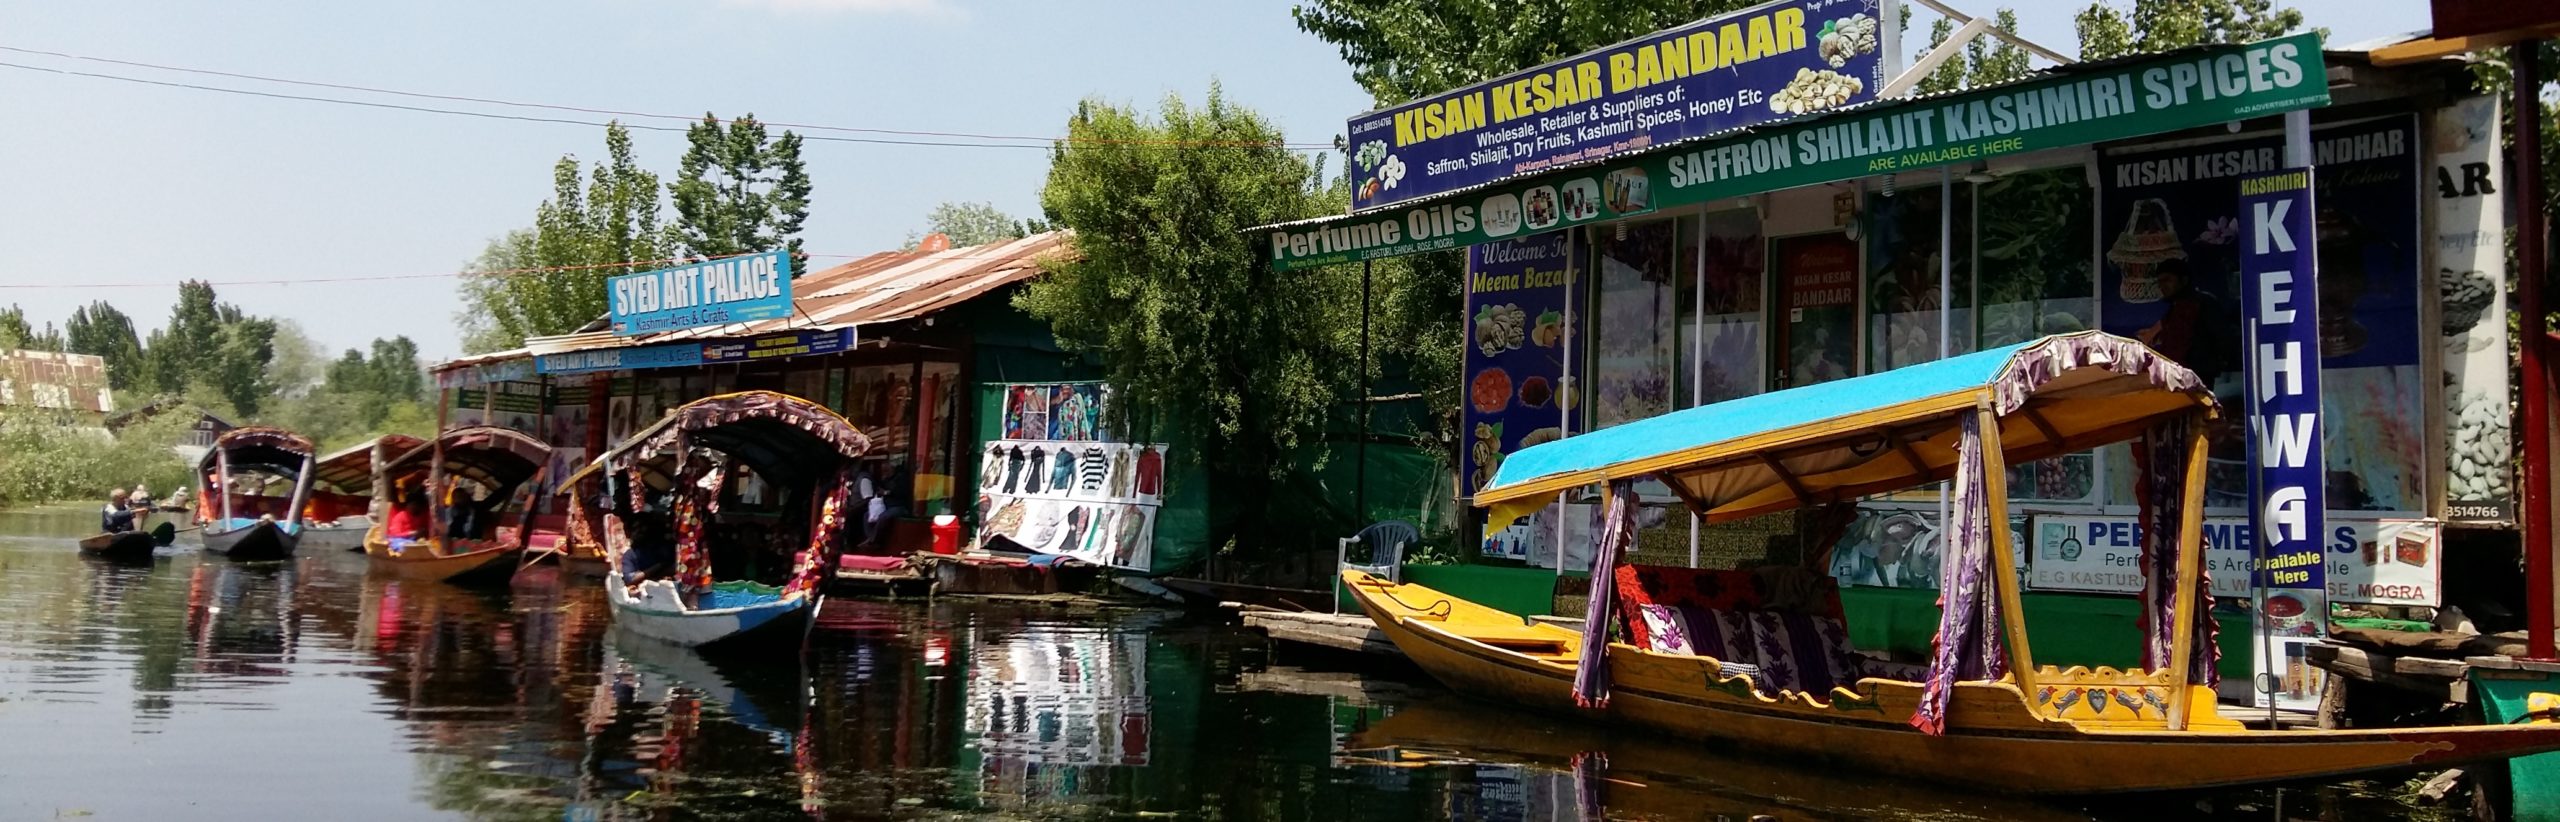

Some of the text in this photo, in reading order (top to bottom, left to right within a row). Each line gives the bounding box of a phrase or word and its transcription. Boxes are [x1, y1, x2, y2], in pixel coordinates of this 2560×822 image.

[1394, 7, 1807, 148] KISAN KESAR BANDAAR
[1476, 85, 1686, 148] Wholesale, Retailer & Suppliers of:
[1668, 43, 2303, 189] SAFFRON SHILAJIT KASHMIRI SPICES
[1352, 124, 1364, 135] Cell:
[1427, 89, 1763, 176] Saffron, Shilajit, Dry Fruits, Kashmiri Spices, Honey Etc
[1868, 137, 2023, 172] ARE AVAILABLE HERE
[2116, 156, 2188, 188] KISAN
[2195, 147, 2275, 180] KESAR
[2241, 172, 2307, 197] KASHMIRI
[1271, 203, 1476, 260] Perfume Oils
[1434, 237, 1455, 249] MOGRA
[1482, 234, 1568, 265] Welcome To
[615, 254, 782, 317] SYED ART PALACE
[1472, 266, 1580, 294] Meena Bazaar
[1794, 271, 1852, 287] KISAN KESAR
[1793, 287, 1852, 307] BANDAAR
[636, 316, 670, 331] Kashmir
[671, 312, 690, 327] Arts
[692, 310, 699, 323] &
[702, 307, 729, 323] Crafts
[568, 353, 586, 370] ART
[587, 350, 622, 369] PALACE
[2254, 551, 2321, 571] Available
[2273, 569, 2309, 585] Here
[2358, 583, 2425, 600] MOGRA
